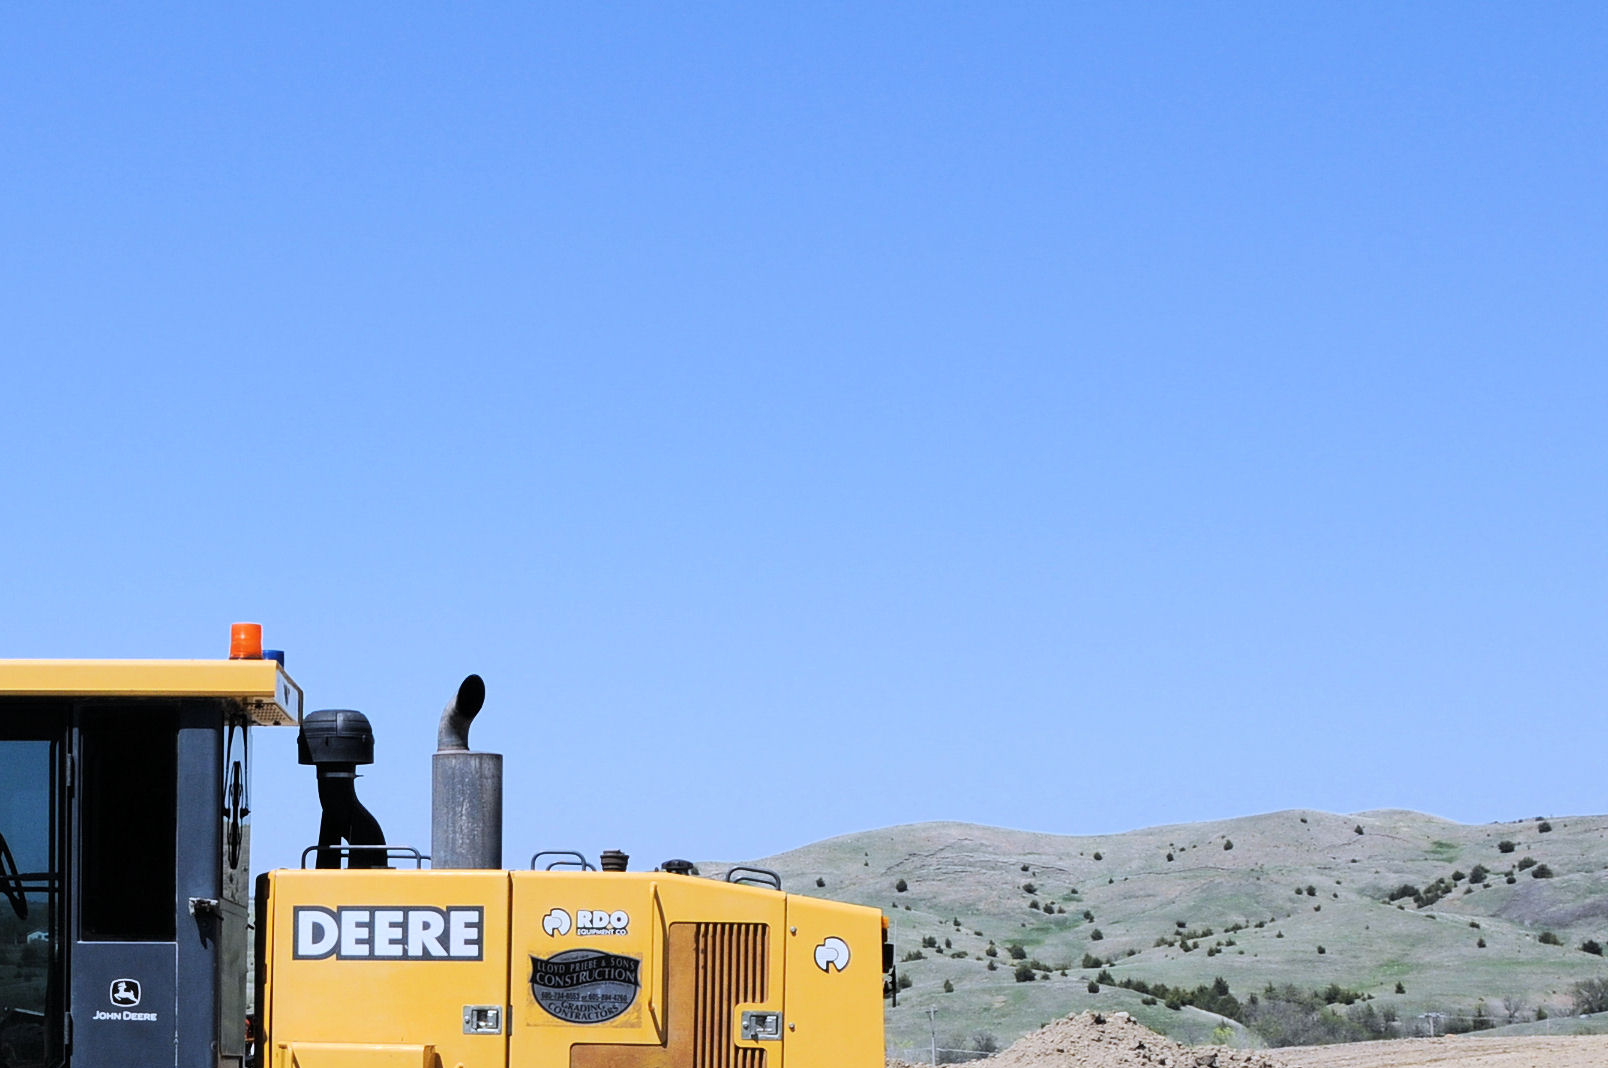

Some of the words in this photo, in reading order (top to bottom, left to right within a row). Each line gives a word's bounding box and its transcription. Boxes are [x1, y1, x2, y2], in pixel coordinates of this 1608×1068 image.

[576, 909, 630, 929] RDO
[295, 907, 482, 959] DEERE
[537, 961, 566, 974] LLOYD
[570, 959, 597, 972] PRIEBE
[600, 959, 607, 967] &
[610, 957, 635, 970] SONS
[536, 967, 635, 987] CONSTRUCTION
[93, 1010, 121, 1020] JOHN
[123, 1010, 158, 1021] DEERE
[548, 1002, 619, 1020] CONTRACTORS
[561, 1000, 605, 1013] GRADING
